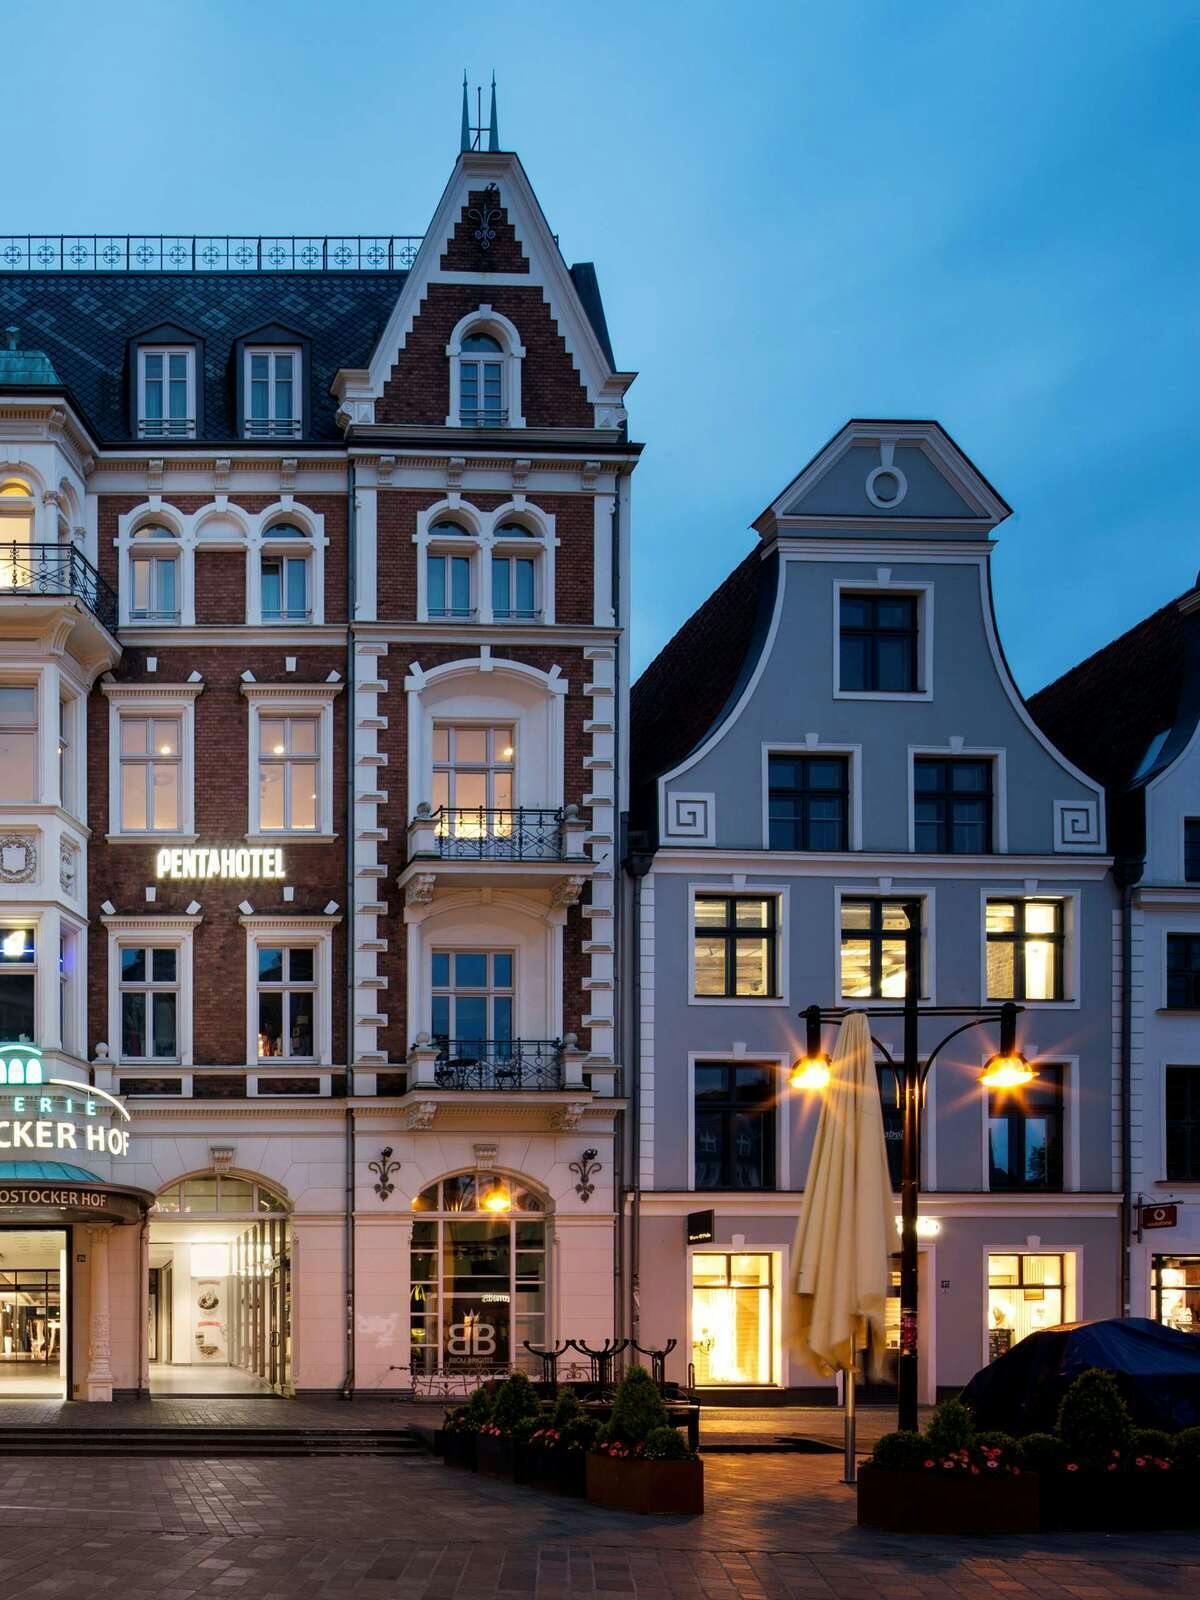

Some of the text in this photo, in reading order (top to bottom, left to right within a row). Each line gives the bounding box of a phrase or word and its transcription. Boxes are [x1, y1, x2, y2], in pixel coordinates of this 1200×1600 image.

[157, 848, 286, 878] PENTAHOTEL
[86, 1124, 130, 1156] HOF
[81, 1192, 107, 1206] HOF
